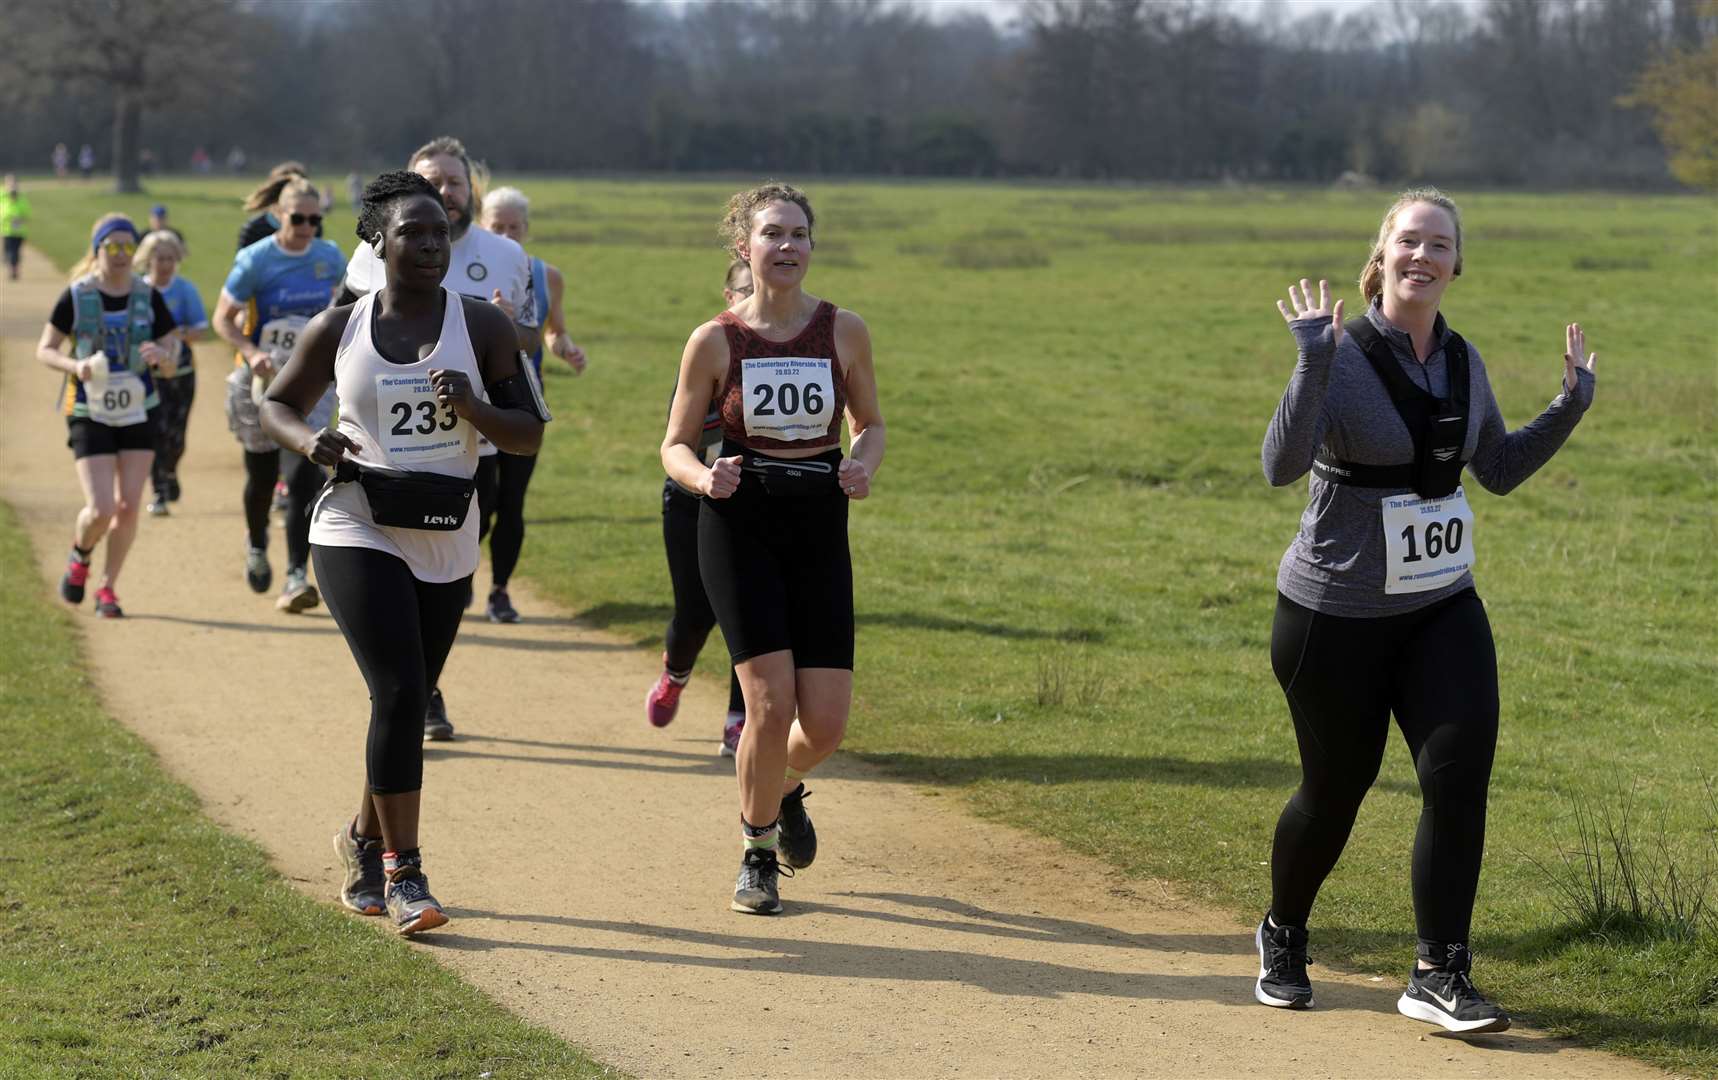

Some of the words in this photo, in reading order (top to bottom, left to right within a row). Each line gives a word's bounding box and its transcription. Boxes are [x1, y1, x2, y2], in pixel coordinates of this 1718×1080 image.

[393, 378, 428, 386] Canterbury
[103, 389, 131, 411] 60
[753, 382, 824, 416] 206
[390, 399, 458, 436] 233
[1330, 466, 1351, 477] FREE
[1390, 501, 1402, 509] The
[1401, 517, 1464, 563] 160
